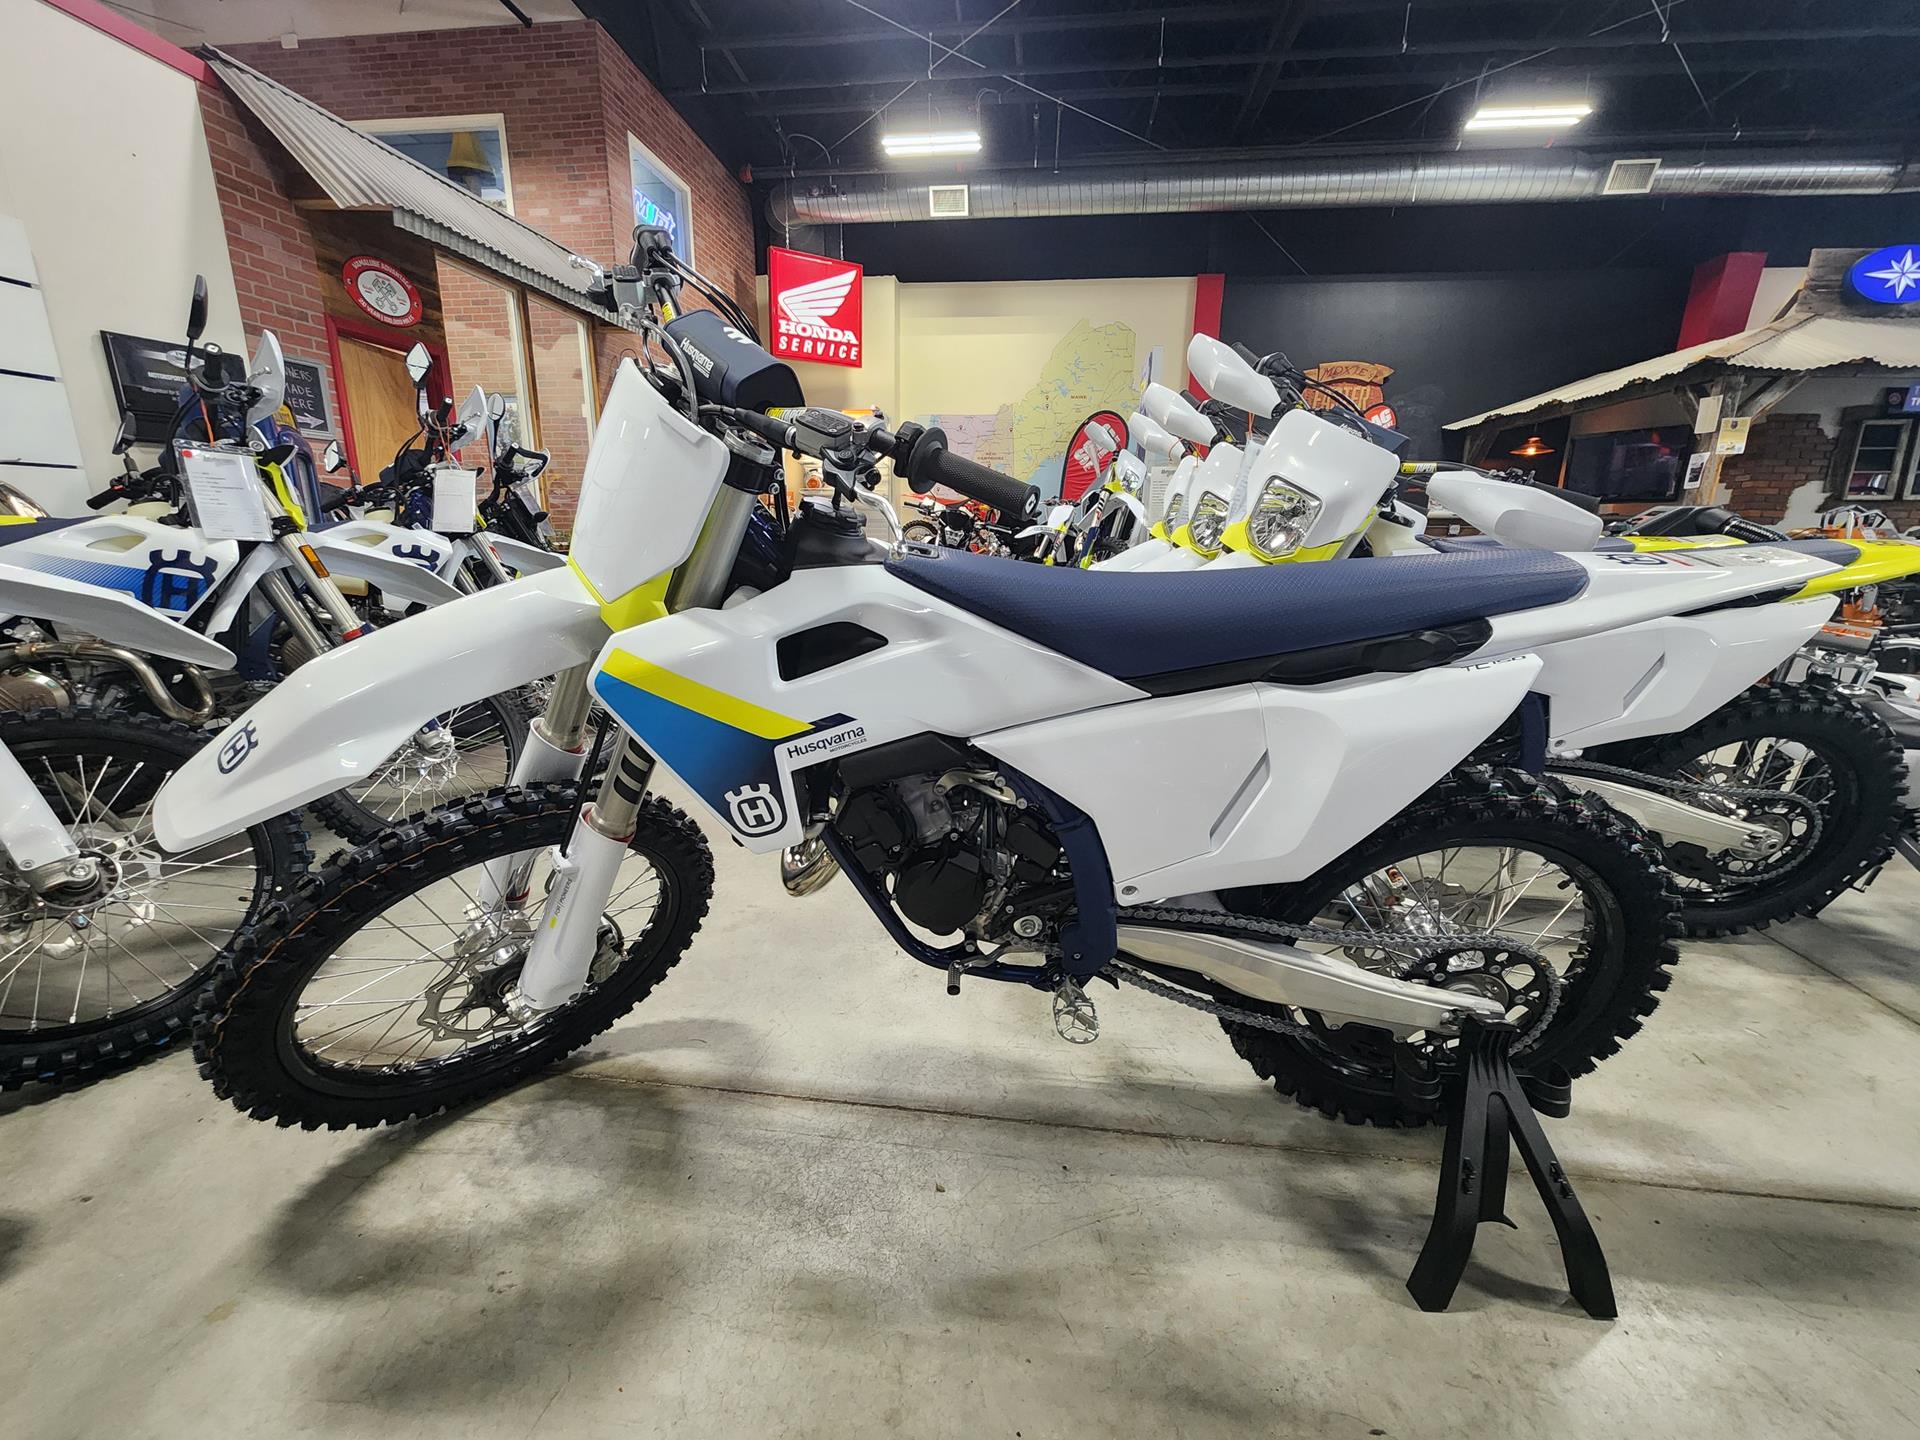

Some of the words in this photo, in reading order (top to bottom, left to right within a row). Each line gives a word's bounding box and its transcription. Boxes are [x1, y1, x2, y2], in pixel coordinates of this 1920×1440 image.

[778, 319, 859, 345] HONDA
[680, 337, 714, 372] Husqvarna
[779, 335, 859, 360] SERVICE
[786, 726, 865, 758] Husqvarna
[829, 738, 868, 753] MOTORCYCLES
